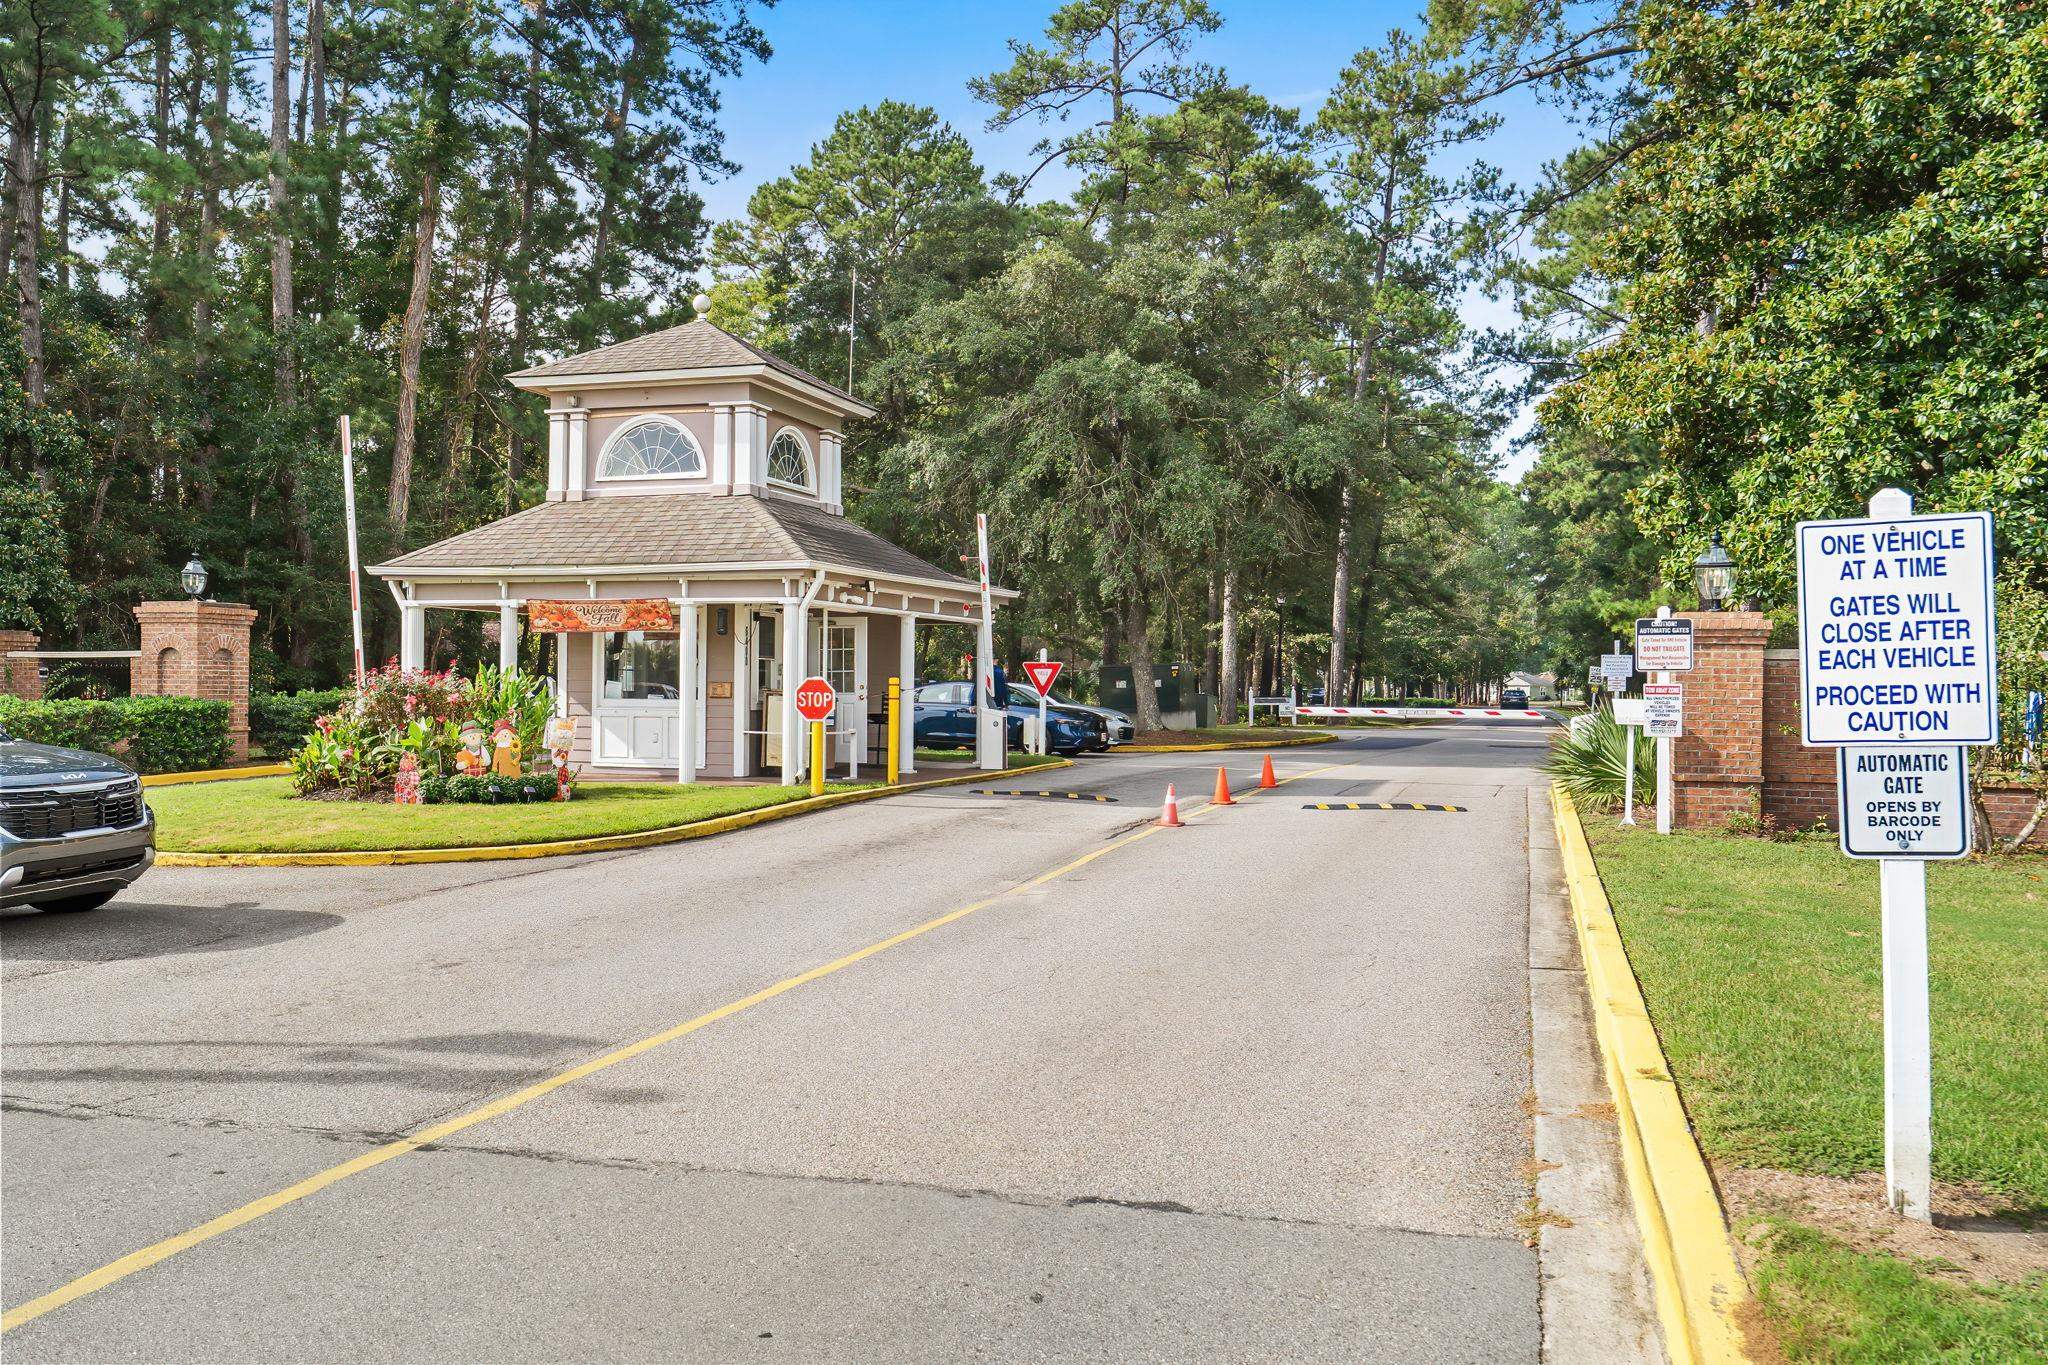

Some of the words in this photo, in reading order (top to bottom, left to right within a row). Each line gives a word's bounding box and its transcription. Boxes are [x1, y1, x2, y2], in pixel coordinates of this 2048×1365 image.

[1821, 534, 1865, 555] ONE
[1872, 528, 1965, 552] VEHICLE
[1840, 559, 1864, 580] AT
[1873, 558, 1888, 579] A
[1895, 556, 1947, 578] TIME
[576, 604, 622, 616] Welcome
[1830, 594, 1900, 617] GATES
[1907, 592, 1960, 614] WILL
[591, 612, 622, 625] Fall
[1821, 621, 1892, 644] CLOSE
[1899, 619, 1970, 642] AFTER
[1819, 648, 1875, 670] EACH
[1883, 646, 1976, 668] VEHICLE
[798, 691, 832, 707] STOP
[1816, 684, 1918, 706] PROCEED
[1925, 683, 1980, 704] WITH
[1848, 710, 1948, 732] CAUTION
[1857, 754, 1948, 773] AUTOMATIC
[1883, 776, 1924, 794] GATE
[1866, 801, 1917, 813] OPENS
[1922, 801, 1941, 813] BY
[1868, 815, 1941, 827] BARCODE
[1886, 830, 1924, 842] ONLY
